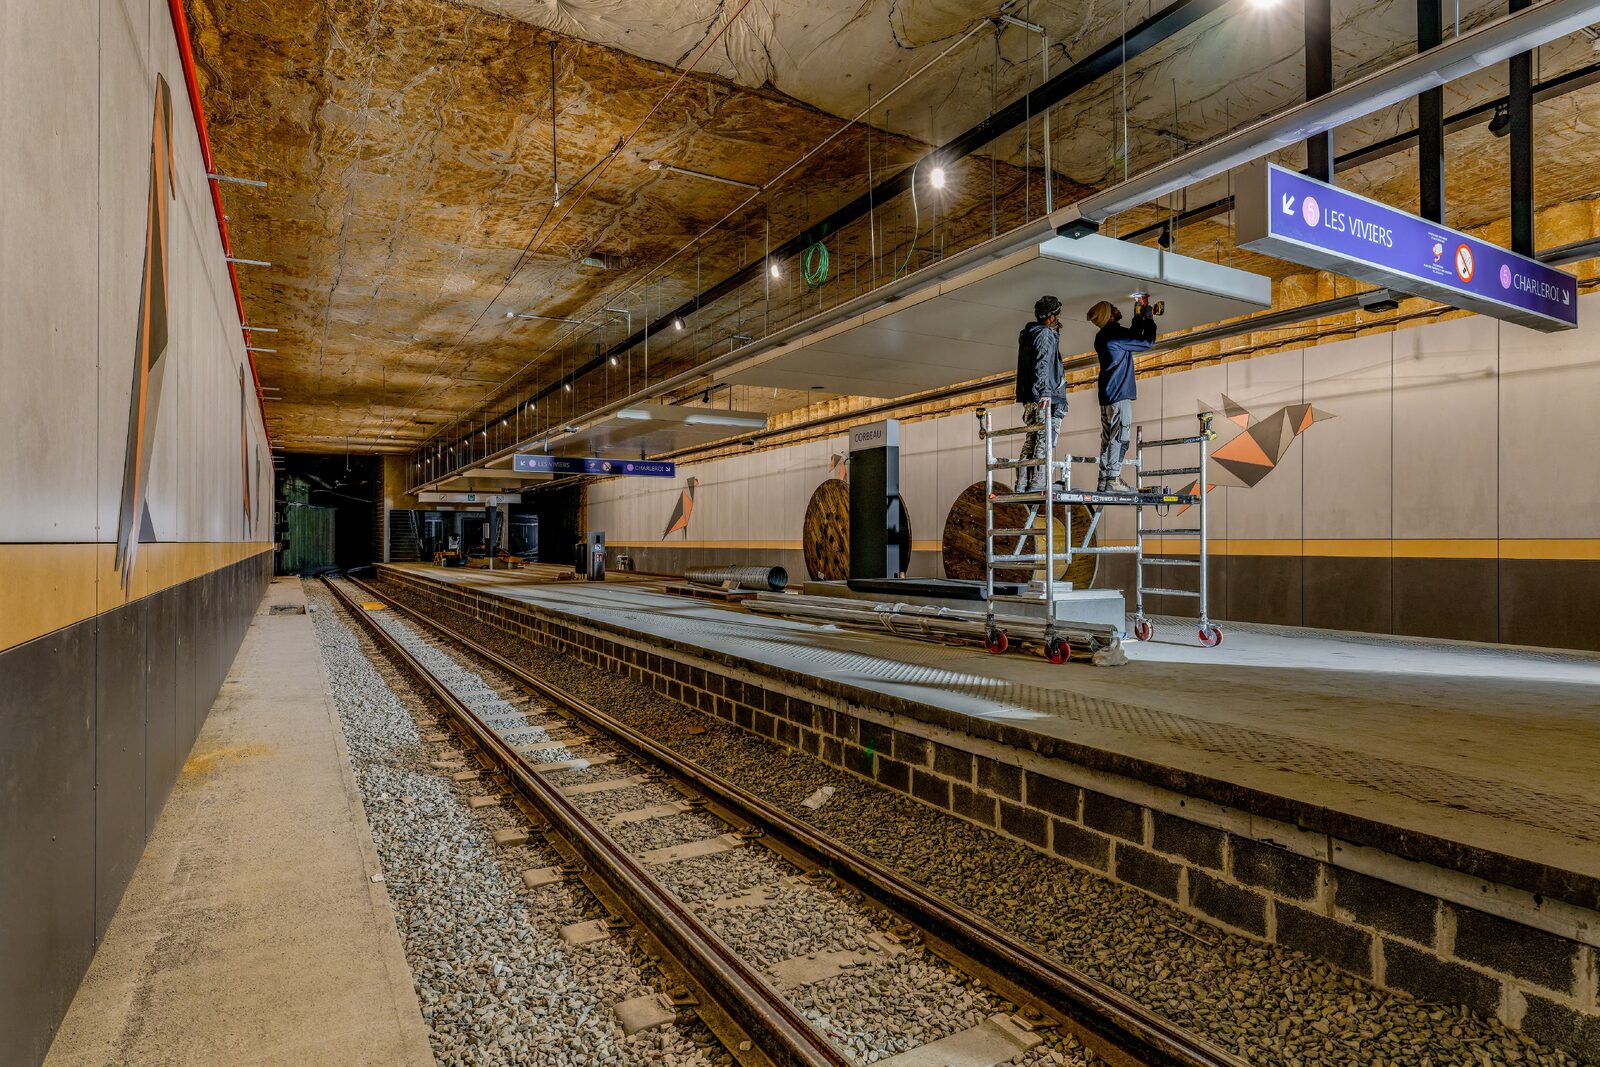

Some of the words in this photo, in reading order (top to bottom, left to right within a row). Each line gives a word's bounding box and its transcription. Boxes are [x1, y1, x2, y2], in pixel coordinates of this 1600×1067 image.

[1324, 207, 1345, 232] LES
[1348, 215, 1393, 248] VIVIERS
[1513, 273, 1560, 302] CHARLEROI
[854, 430, 882, 443] CORBEAU
